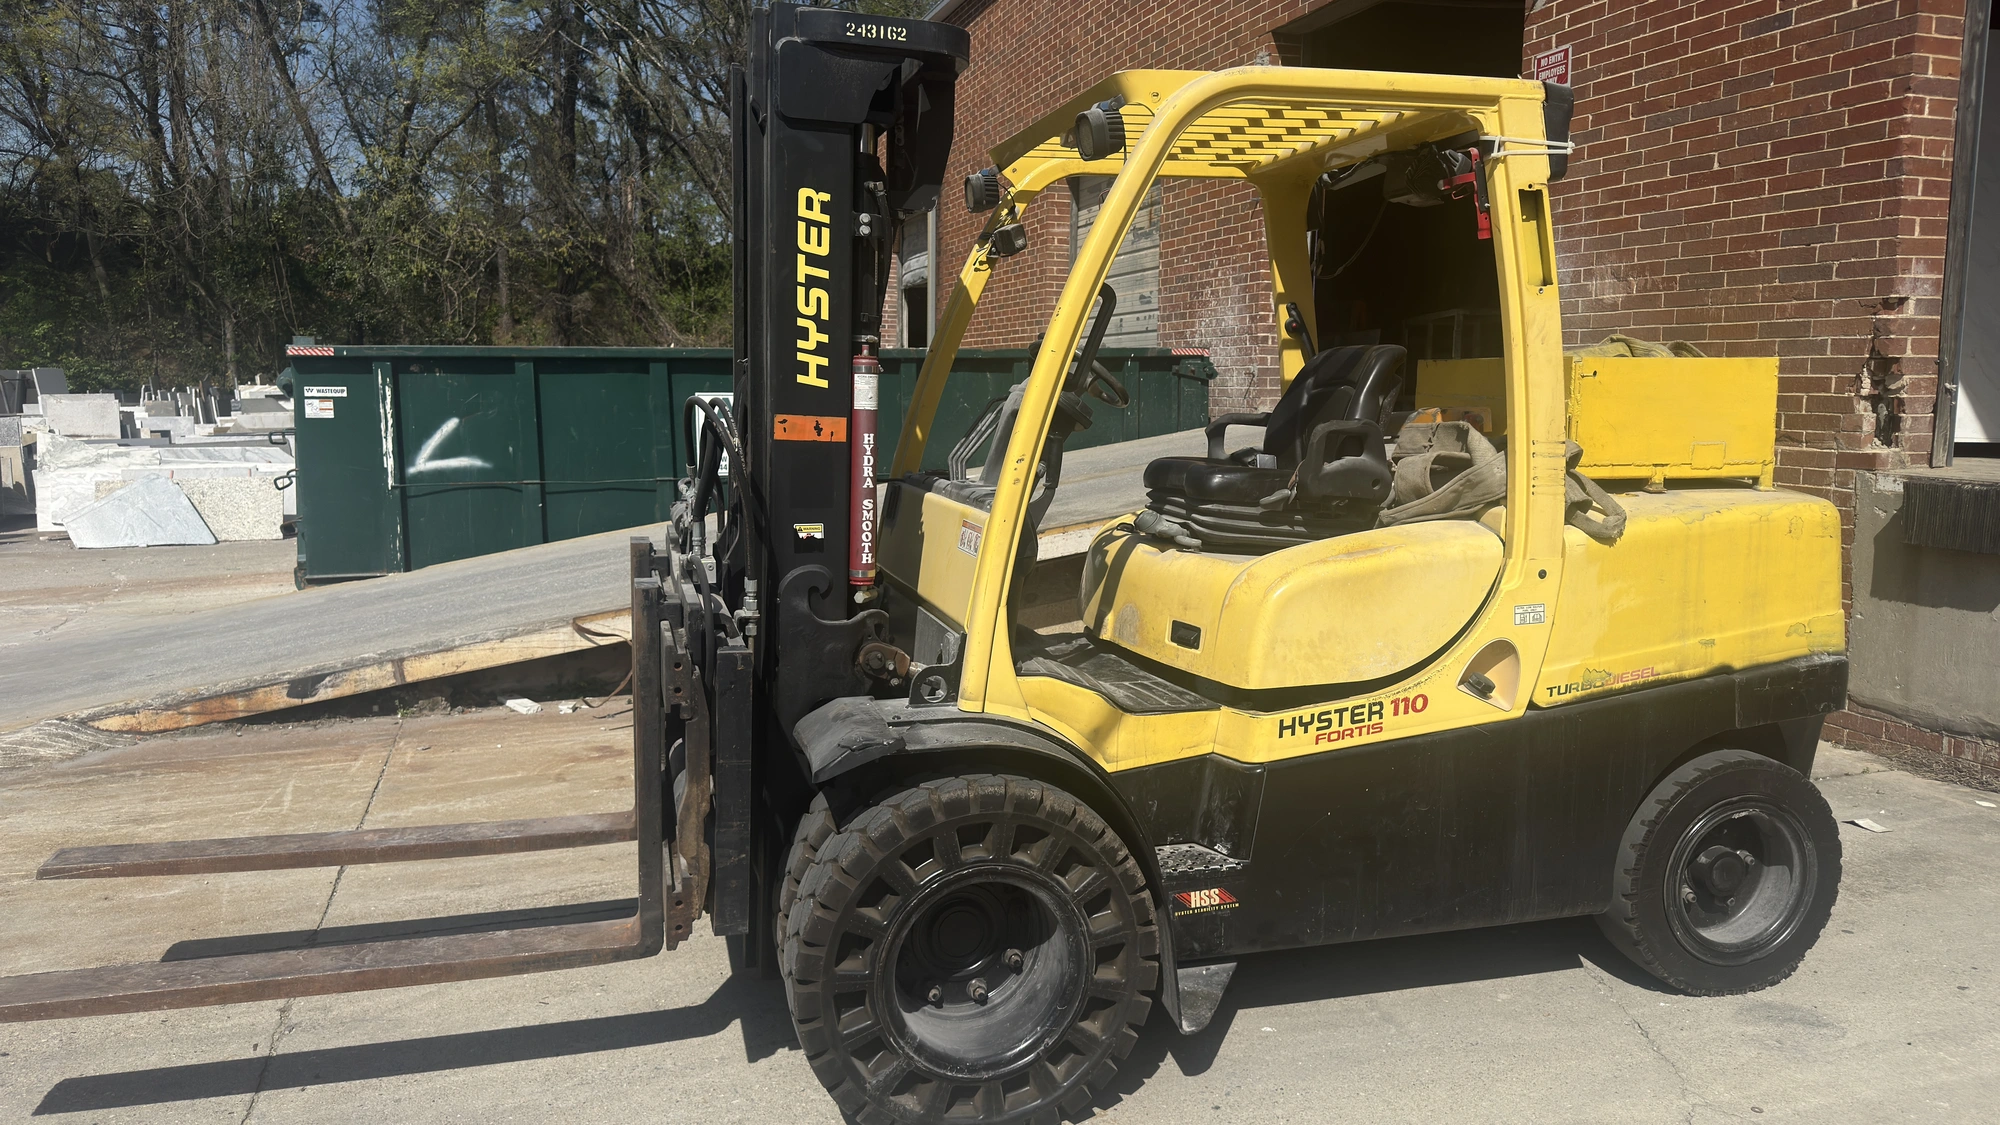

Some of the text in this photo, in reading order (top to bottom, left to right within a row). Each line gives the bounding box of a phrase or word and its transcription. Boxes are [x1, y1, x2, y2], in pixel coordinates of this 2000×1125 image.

[846, 22, 907, 41] 243162
[1540, 52, 1564, 67] NO ENTRY
[1539, 65, 1566, 80] EMPLOYEES
[797, 187, 831, 389] HYSTER
[861, 433, 875, 564] HYDRA SMOOTH
[1278, 693, 1429, 739] HYSTER 110
[1315, 721, 1384, 745] FORTIS
[1190, 888, 1220, 908] HSS
